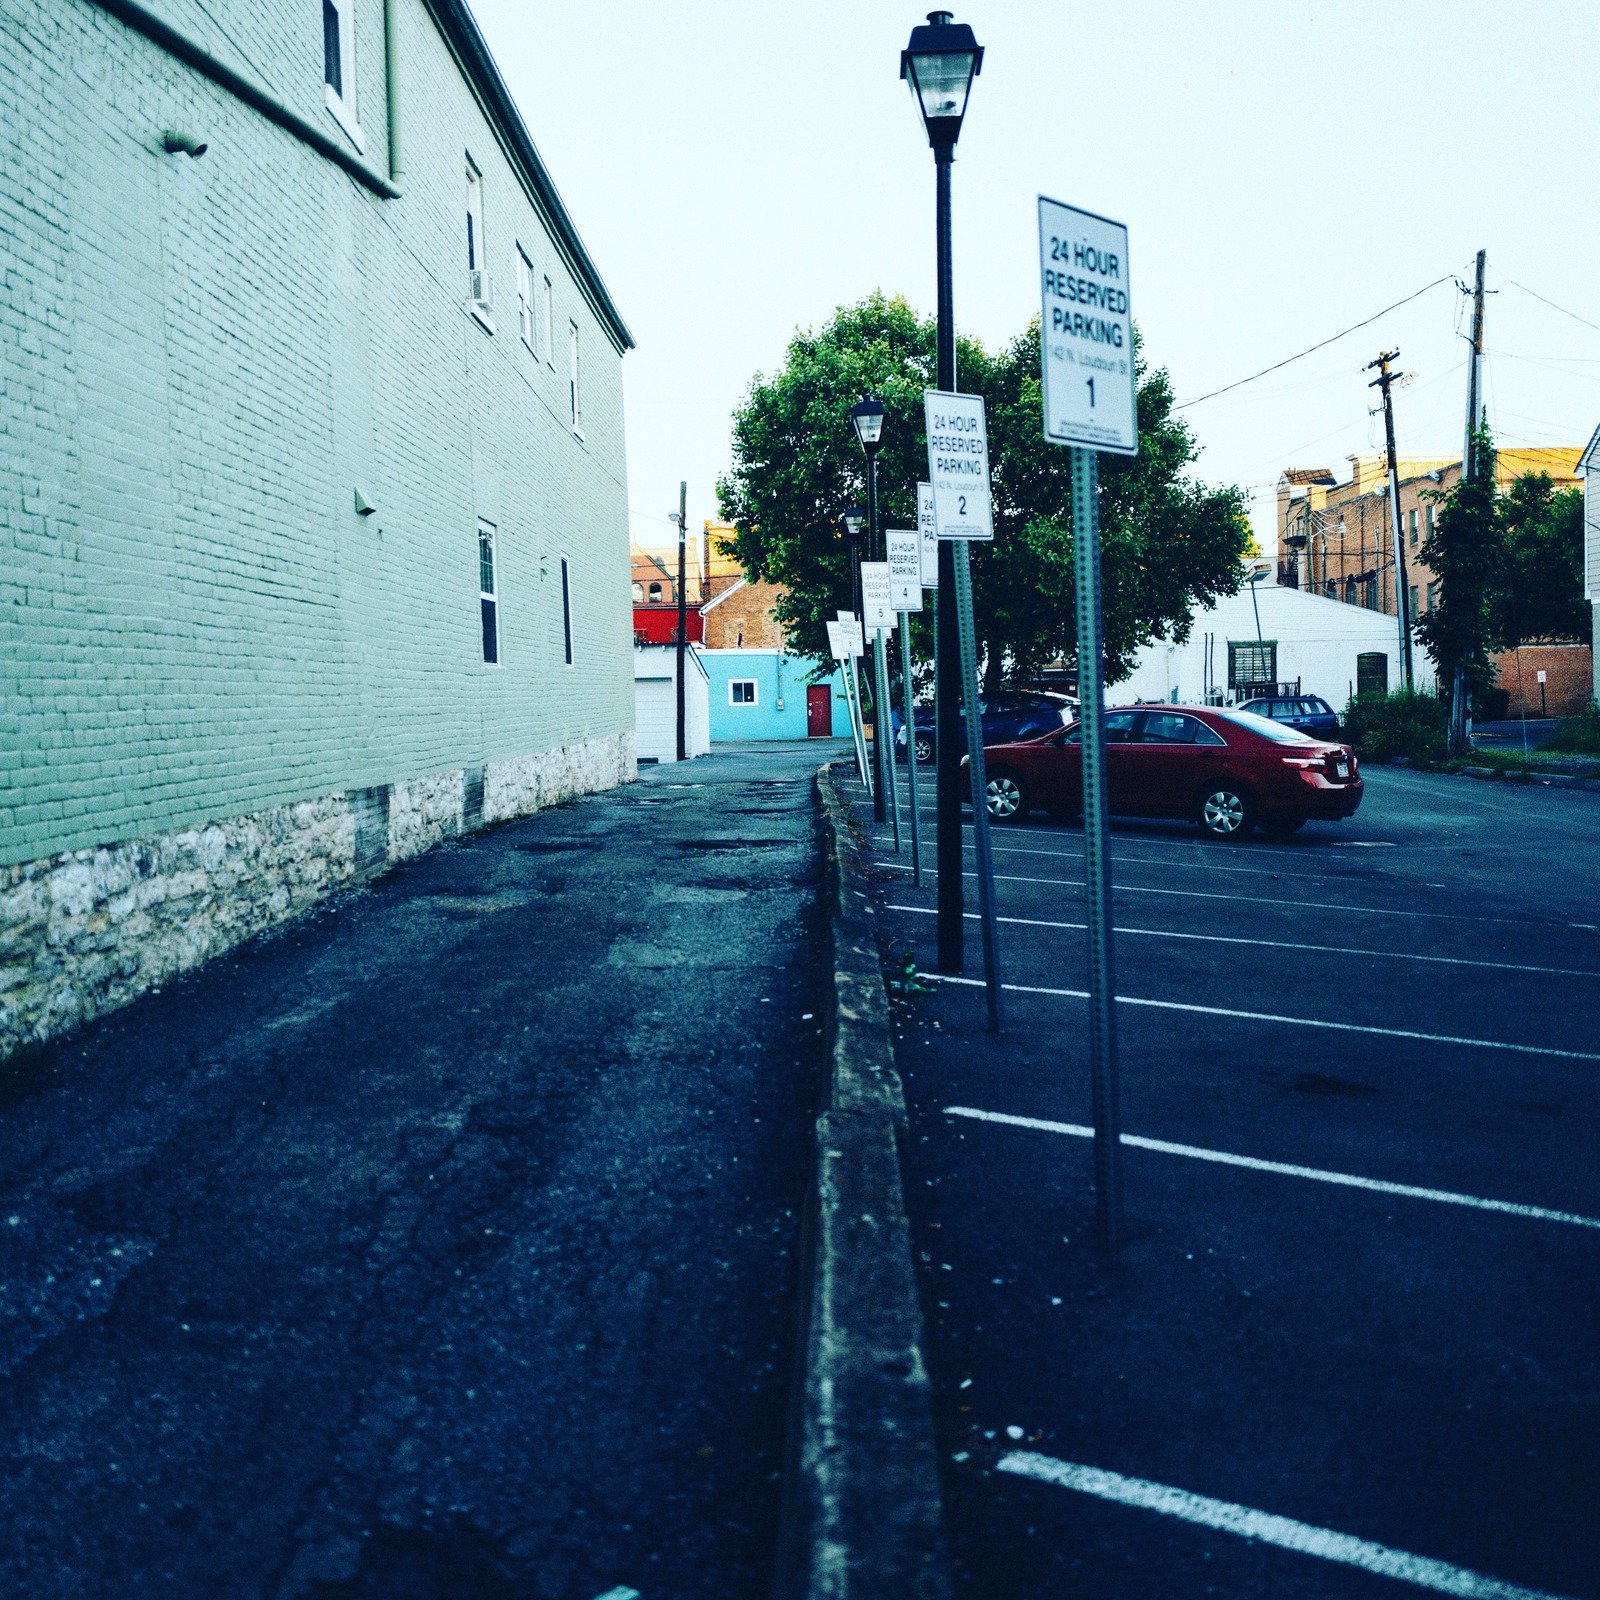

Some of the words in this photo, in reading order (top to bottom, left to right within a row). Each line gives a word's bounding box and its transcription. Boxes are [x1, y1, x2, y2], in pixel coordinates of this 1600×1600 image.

[1050, 236, 1069, 262] 24
[1073, 243, 1120, 279] HOUR
[1045, 269, 1128, 315] RESERVED
[1053, 307, 1124, 348] PARKING
[1085, 376, 1096, 408] 1
[934, 414, 946, 430] 24
[949, 416, 978, 433] HOUR
[931, 435, 984, 455] RESERVED
[937, 457, 982, 476] PARKING
[924, 499, 934, 511] 24
[958, 495, 967, 515] 2
[891, 542, 898, 552] 24
[898, 543, 915, 552] HOUR
[889, 554, 918, 564] RESERVED
[866, 572, 873, 580] 24
[892, 566, 917, 576] PARKING
[864, 581, 889, 590] RESERVE
[902, 587, 908, 598] 4
[878, 608, 884, 618] 5
